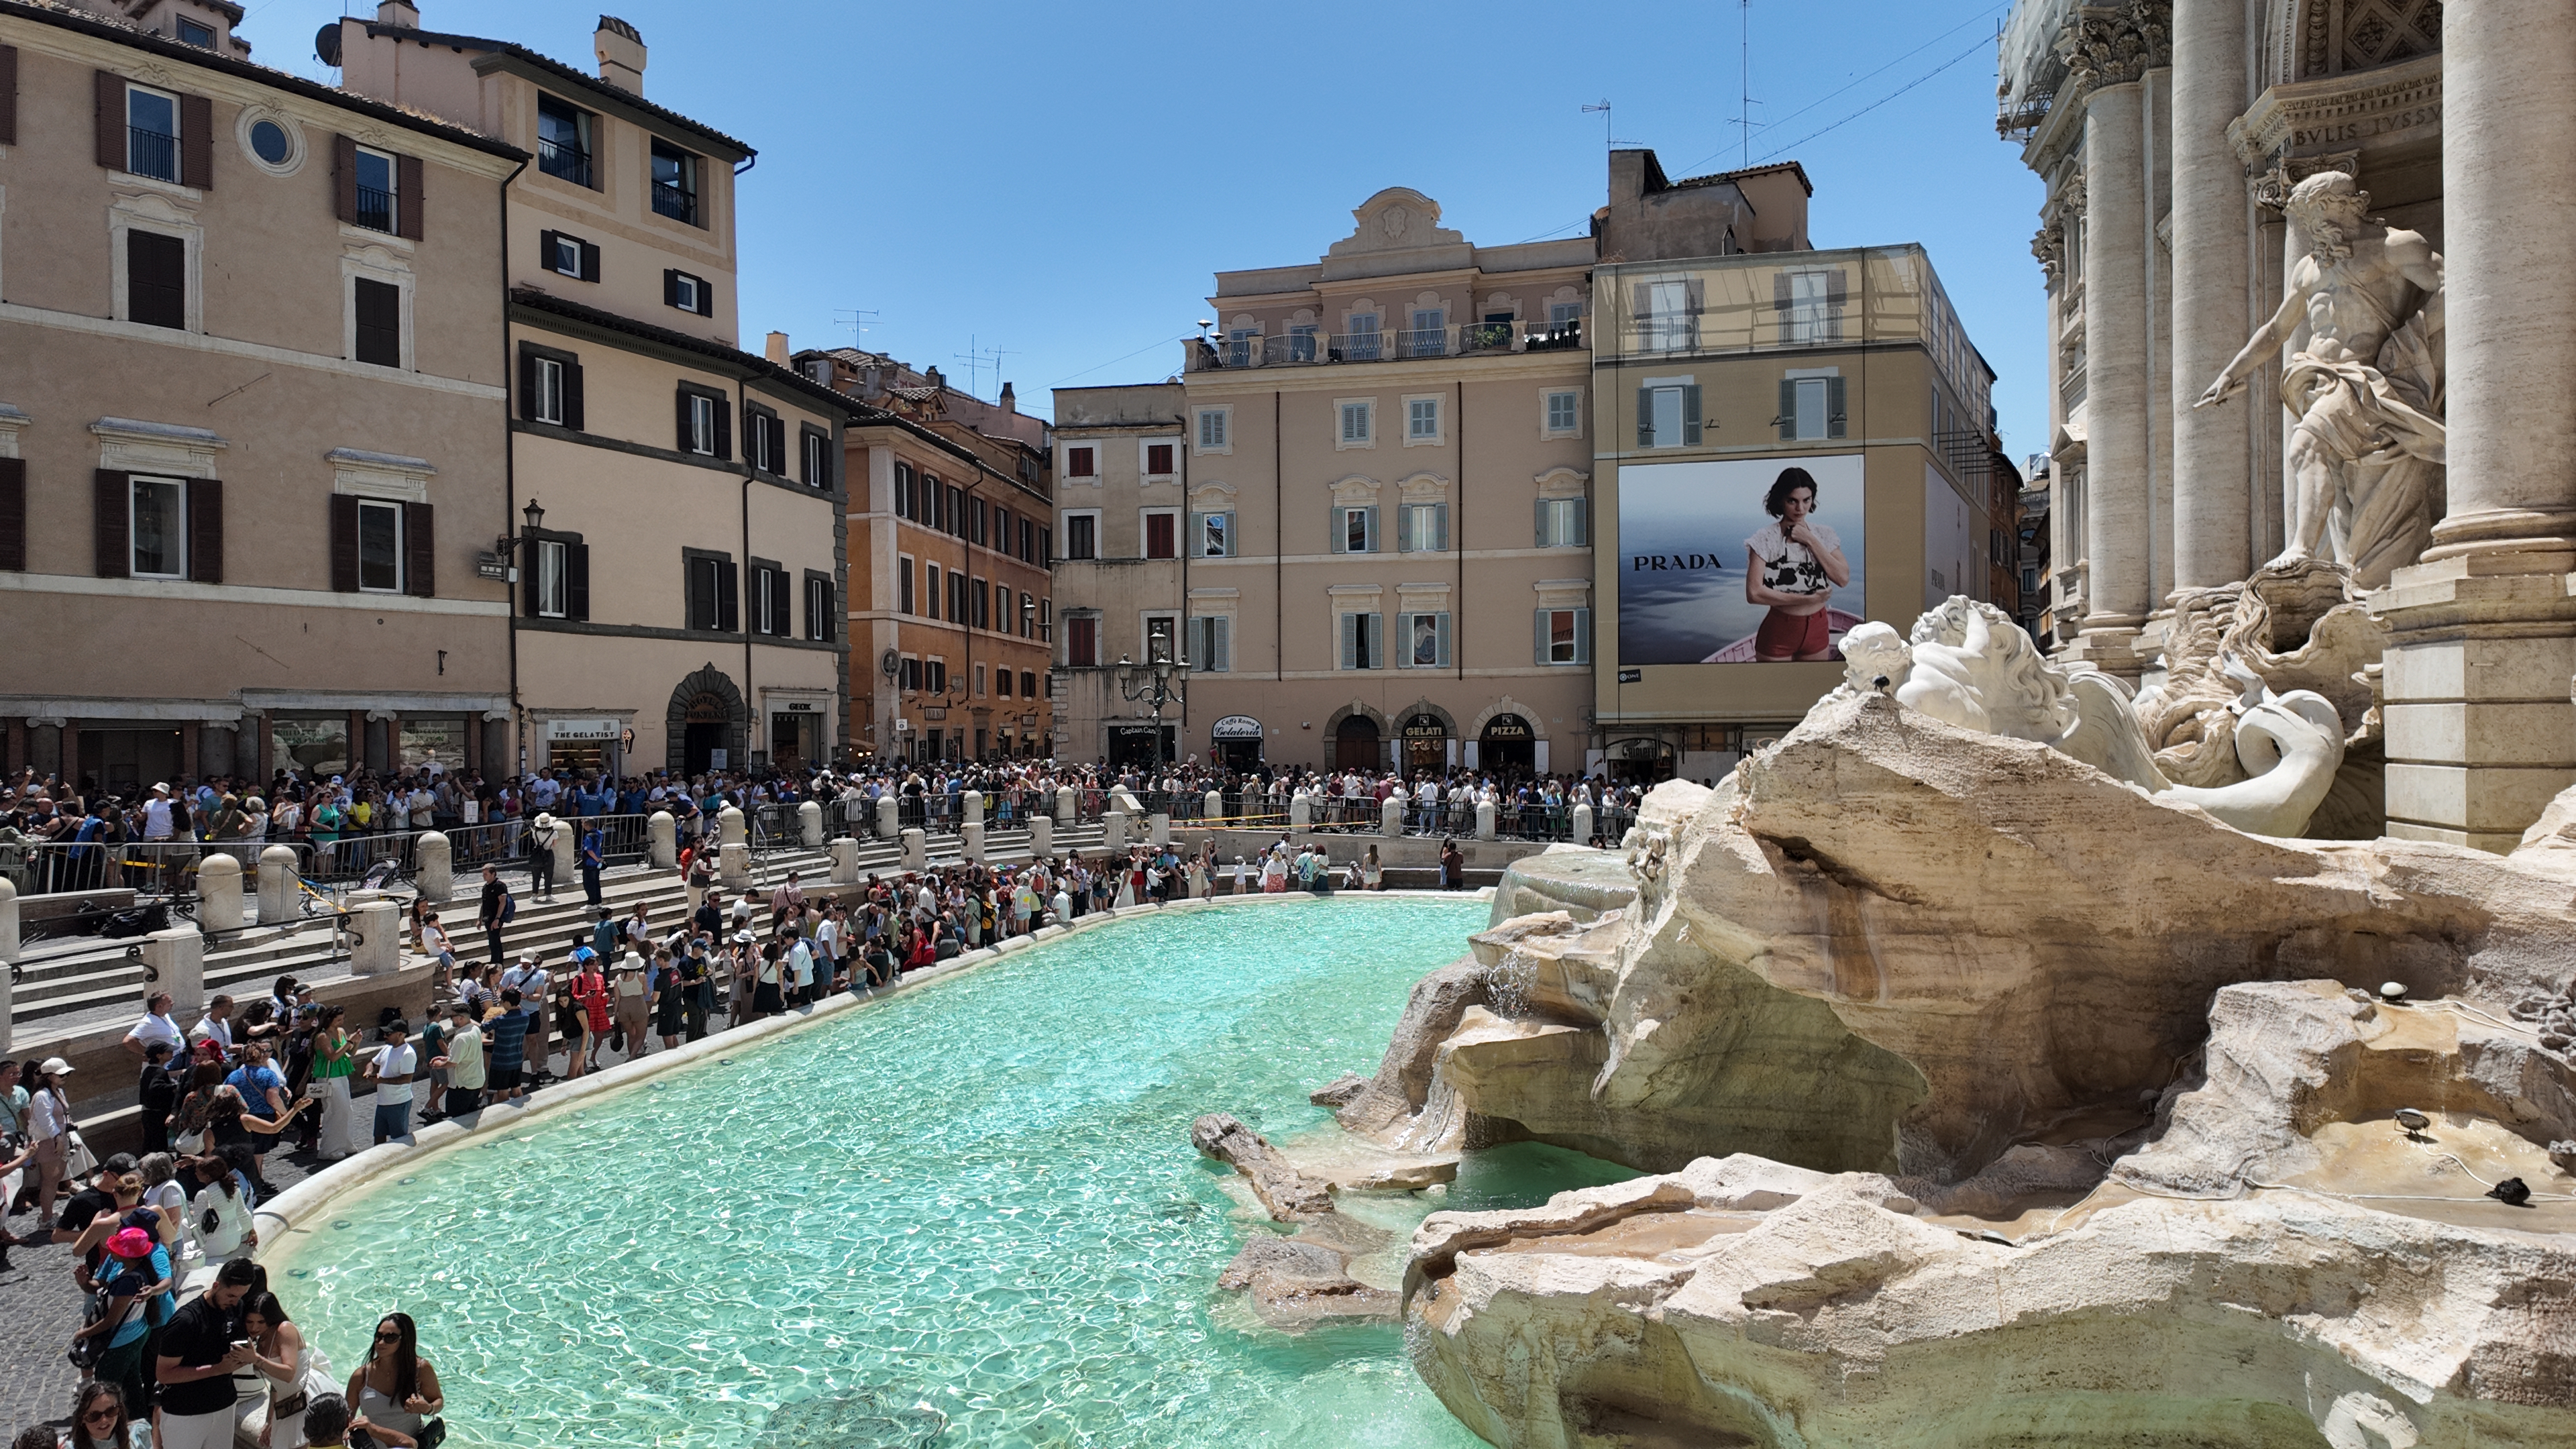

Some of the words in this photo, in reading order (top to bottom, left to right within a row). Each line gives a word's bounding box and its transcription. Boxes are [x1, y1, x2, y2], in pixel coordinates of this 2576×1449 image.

[1633, 553, 1722, 571] PRADA
[789, 702, 812, 711] GEOX
[1120, 726, 1143, 736] Captain
[1215, 727, 1260, 736] Gelateria
[1405, 727, 1442, 736] GELATI
[1491, 726, 1525, 736] PIZZA
